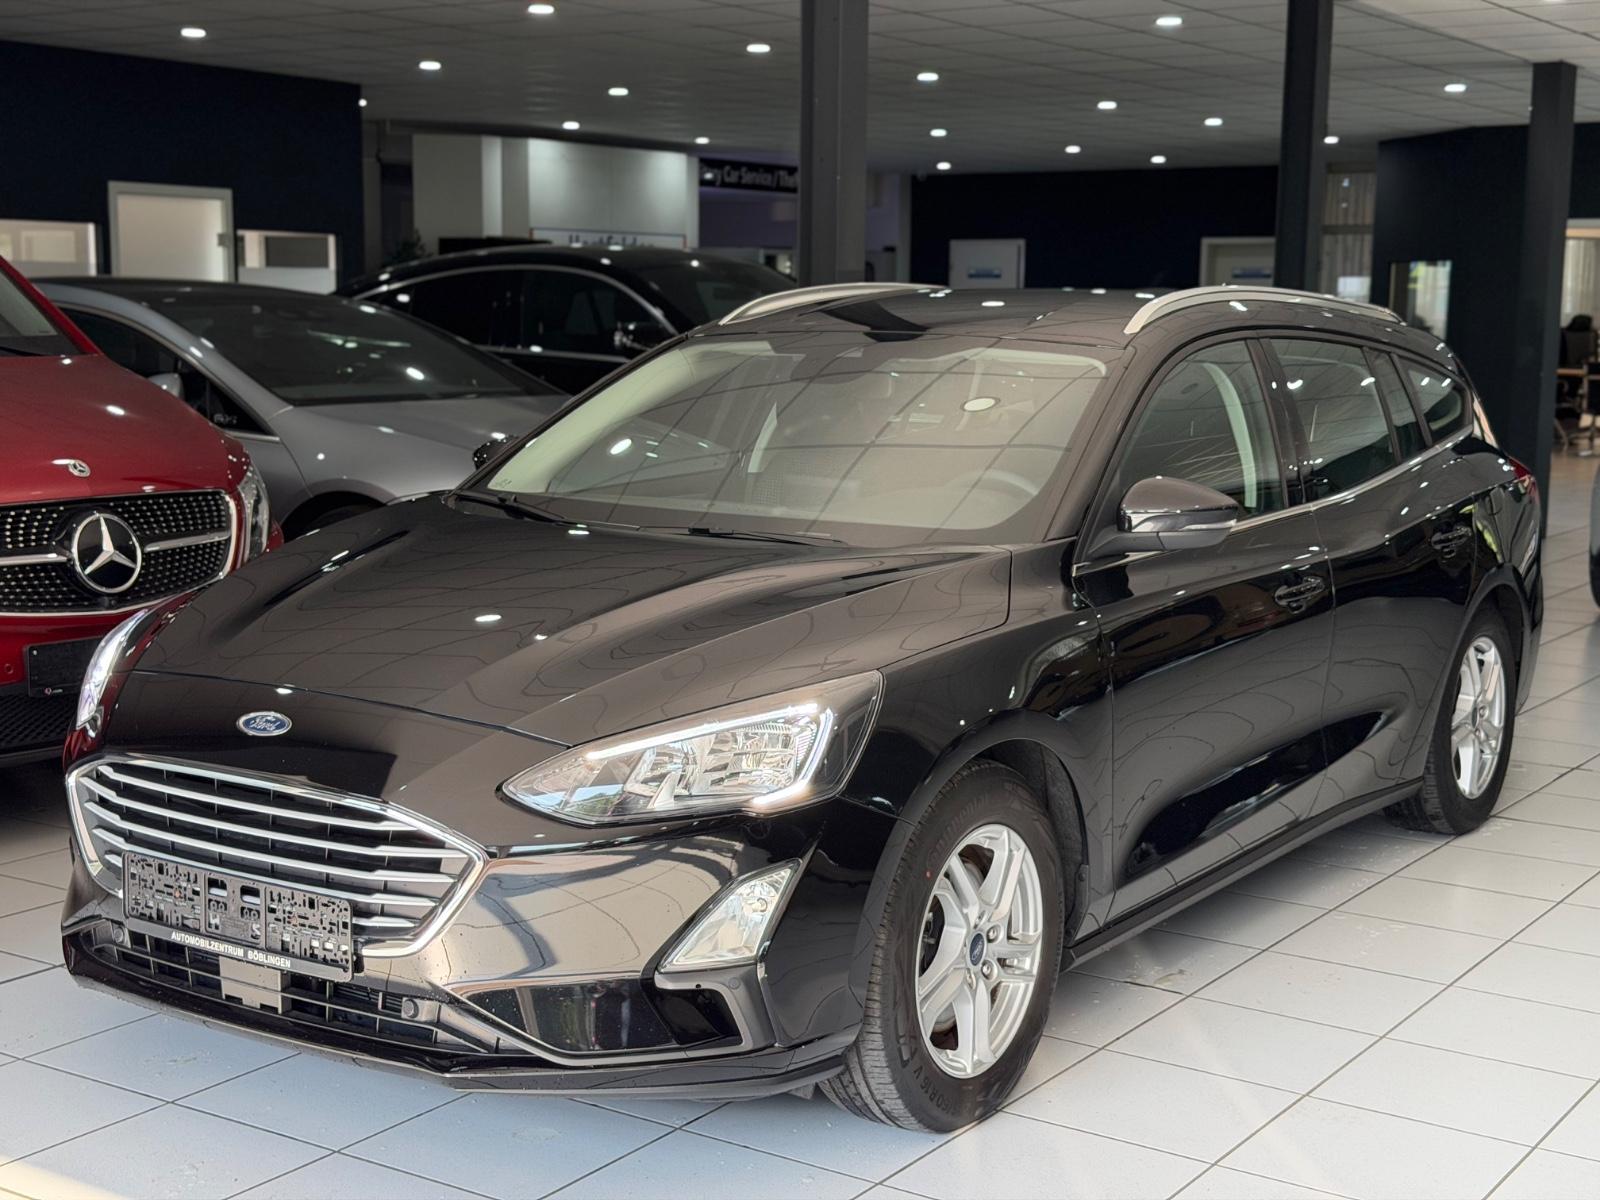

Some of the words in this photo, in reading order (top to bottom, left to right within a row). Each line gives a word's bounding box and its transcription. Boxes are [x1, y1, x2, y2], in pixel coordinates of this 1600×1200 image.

[723, 165, 740, 184] Car
[741, 166, 772, 187] Service
[171, 931, 244, 957] AUTOMOBILZENTRUM
[248, 950, 291, 969] BÖBLINGEN
